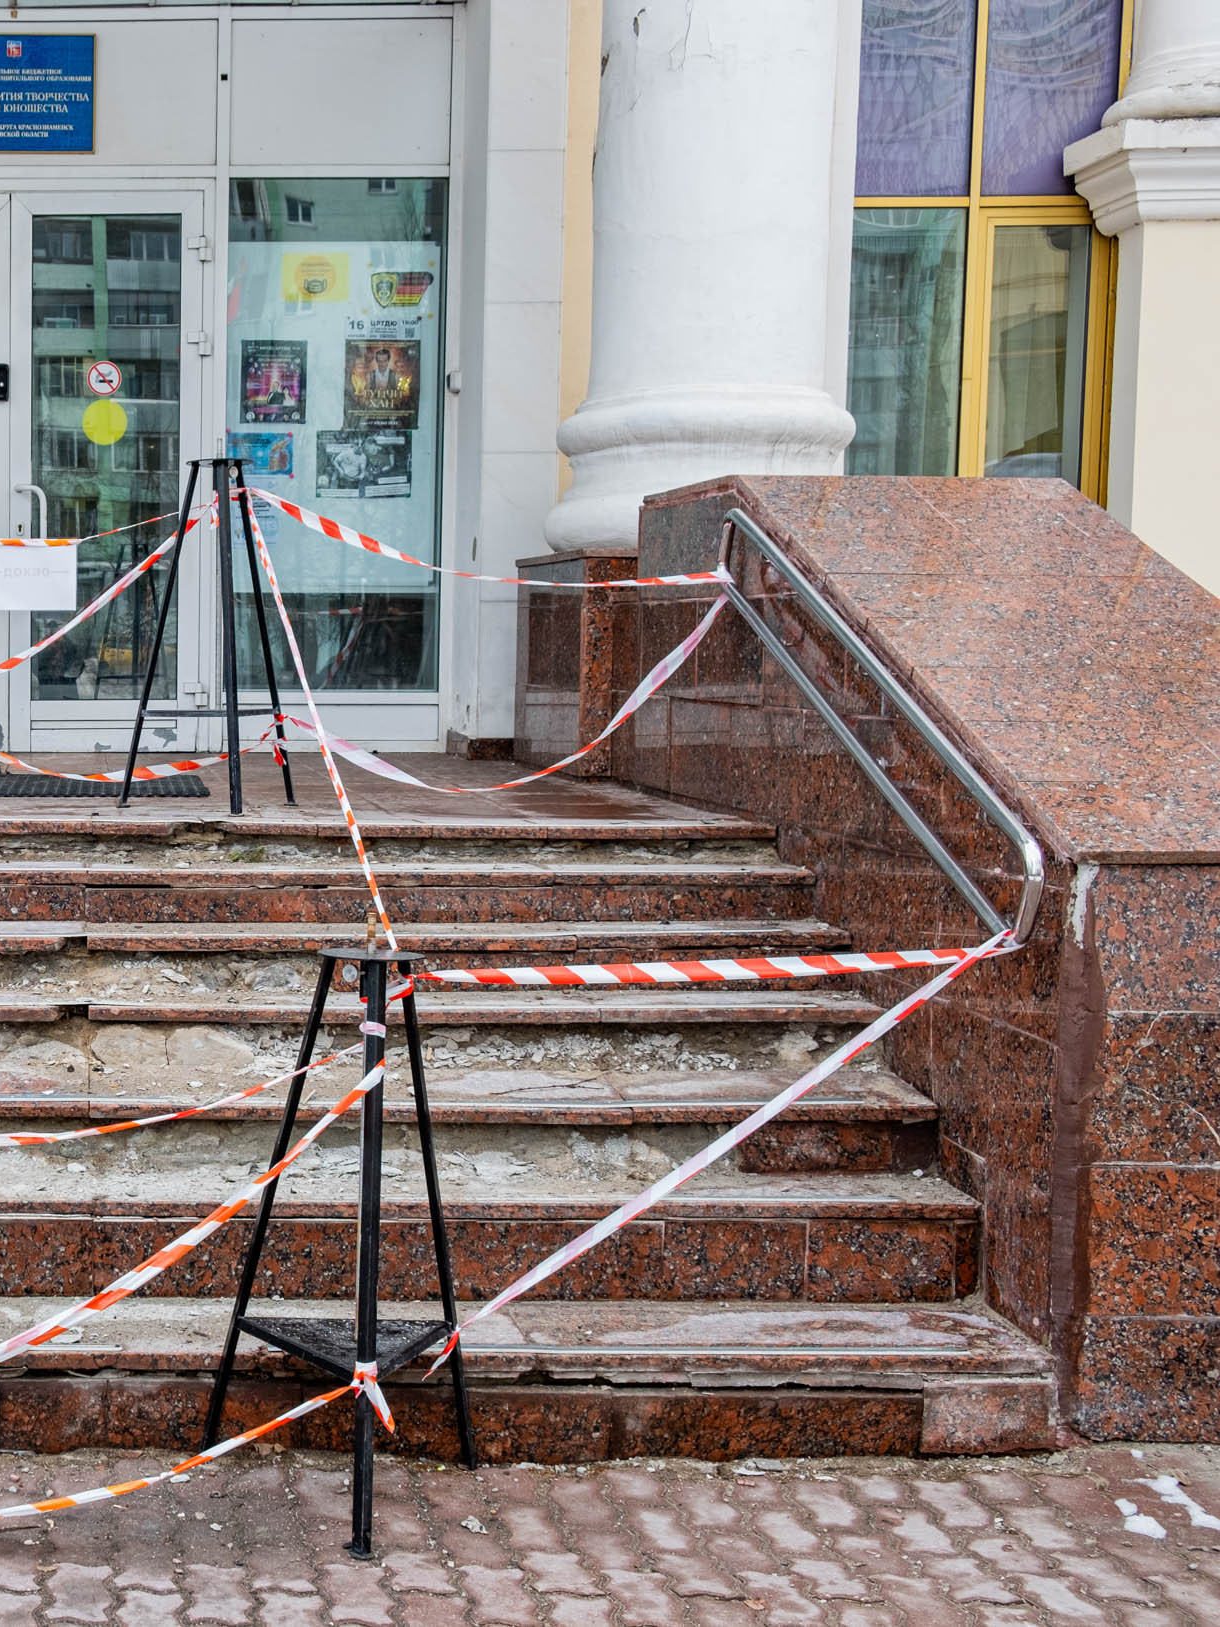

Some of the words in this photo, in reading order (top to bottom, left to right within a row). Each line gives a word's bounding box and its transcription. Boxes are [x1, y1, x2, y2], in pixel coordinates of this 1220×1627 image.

[25, 92, 90, 101] ТВОРЧЕСТВА
[3, 104, 69, 113] ЮНОШЕСТВА
[348, 320, 365, 330] 16
[370, 320, 398, 328] ЦРТДЮ
